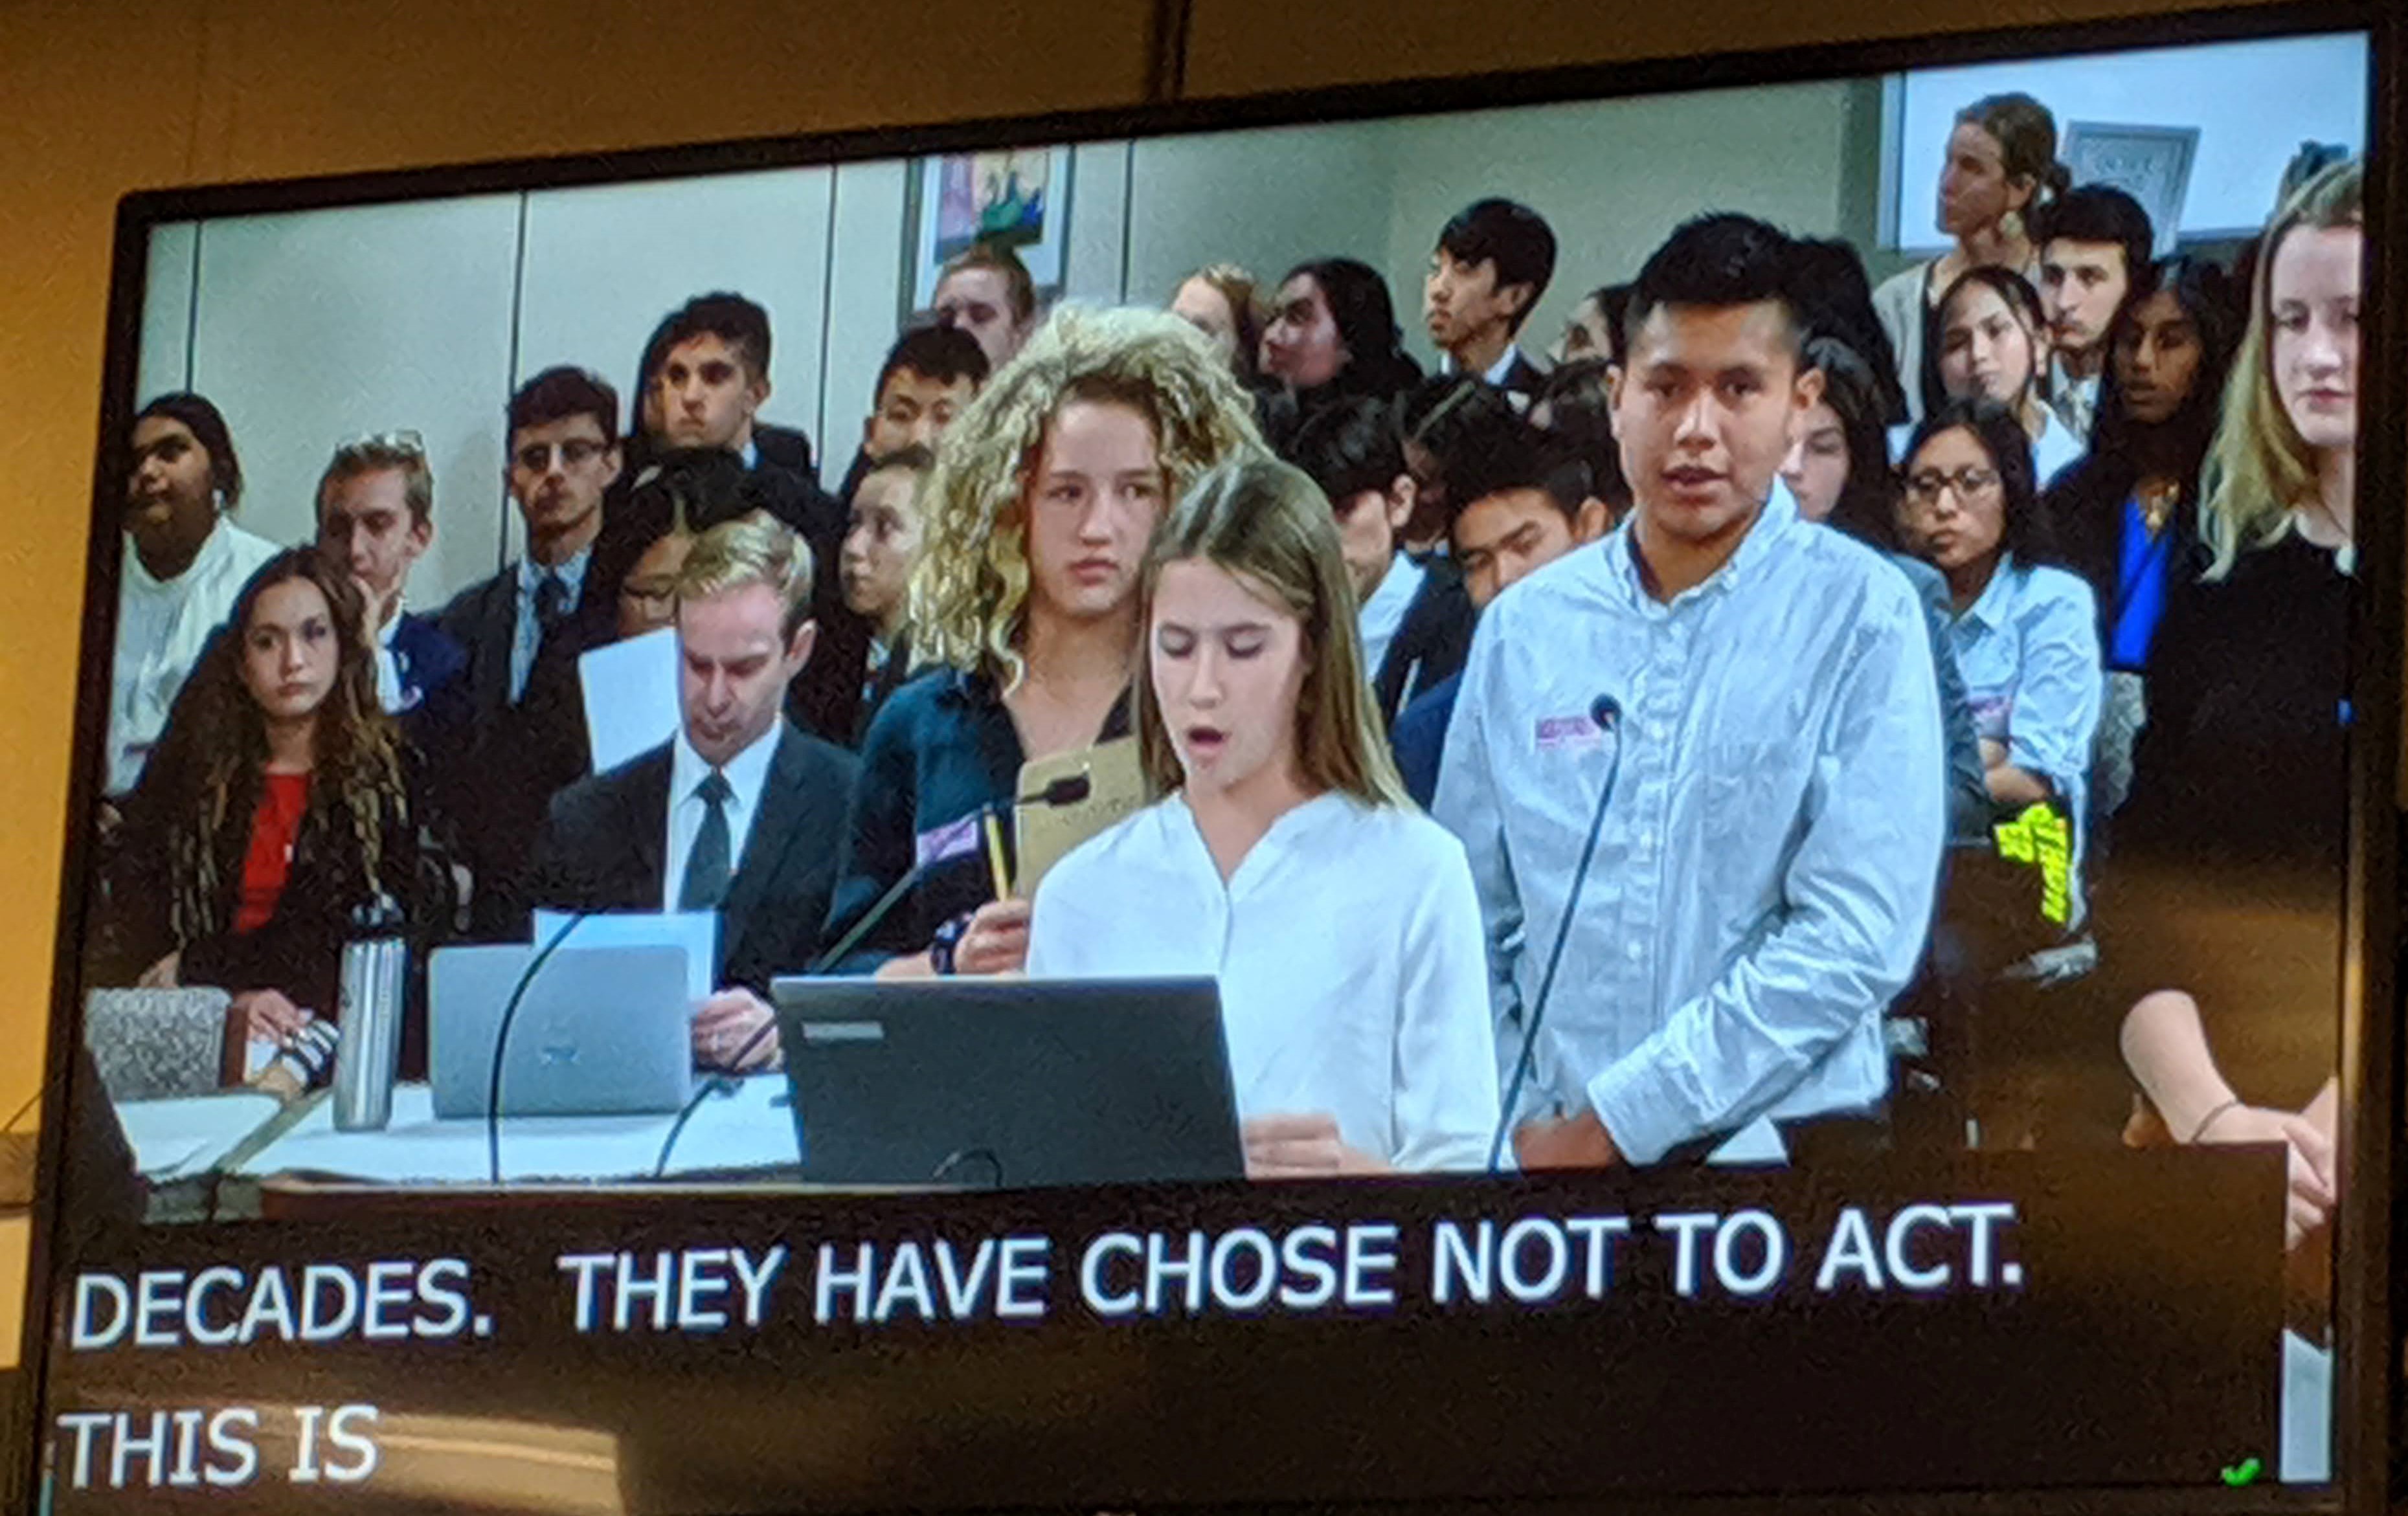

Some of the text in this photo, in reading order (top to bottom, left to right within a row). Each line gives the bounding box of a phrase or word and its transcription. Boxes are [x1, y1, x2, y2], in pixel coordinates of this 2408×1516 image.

[71, 1203, 2023, 1349] DECADES. THEY HAVE CHOSE NOT TO ACT.
[56, 1405, 380, 1488] THIS IS
